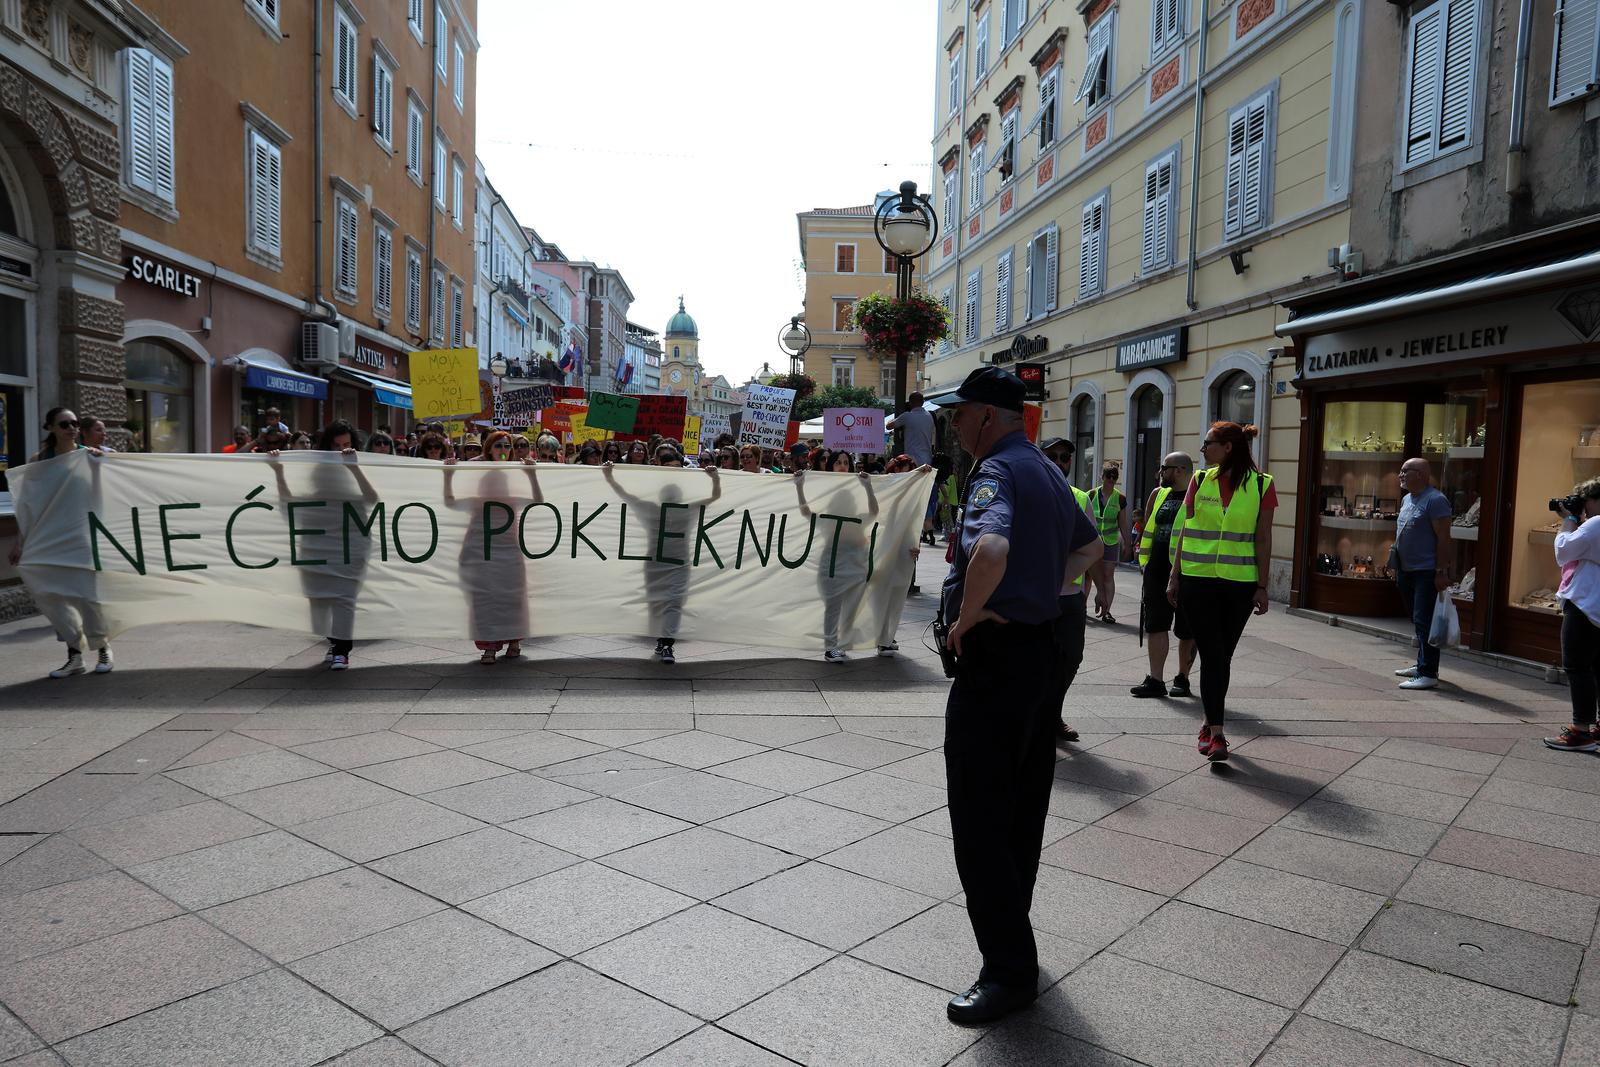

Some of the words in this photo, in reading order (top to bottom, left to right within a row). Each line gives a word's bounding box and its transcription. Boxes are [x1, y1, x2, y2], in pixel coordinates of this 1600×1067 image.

[131, 255, 202, 298] SCARLET
[355, 345, 386, 370] ANTINEA
[1119, 334, 1176, 367] NARACAMICIE
[1308, 347, 1379, 372] ZLATARNA
[1400, 325, 1509, 359] JEWELLERY
[503, 384, 552, 402] SESTRINSTVO
[427, 398, 475, 415] OMLET
[508, 397, 553, 414] JEDINSTVO
[746, 401, 763, 409] BEST
[766, 404, 777, 412] FOR
[779, 405, 790, 414] YOU
[742, 421, 757, 432] YOU
[758, 426, 774, 434] KNOW
[741, 433, 762, 445] BEST
[763, 437, 772, 445] FOR
[773, 438, 785, 448] YOU
[88, 502, 207, 576] NE
[225, 484, 439, 569] ĆEMO
[483, 501, 880, 582] POKLEKNUTI
